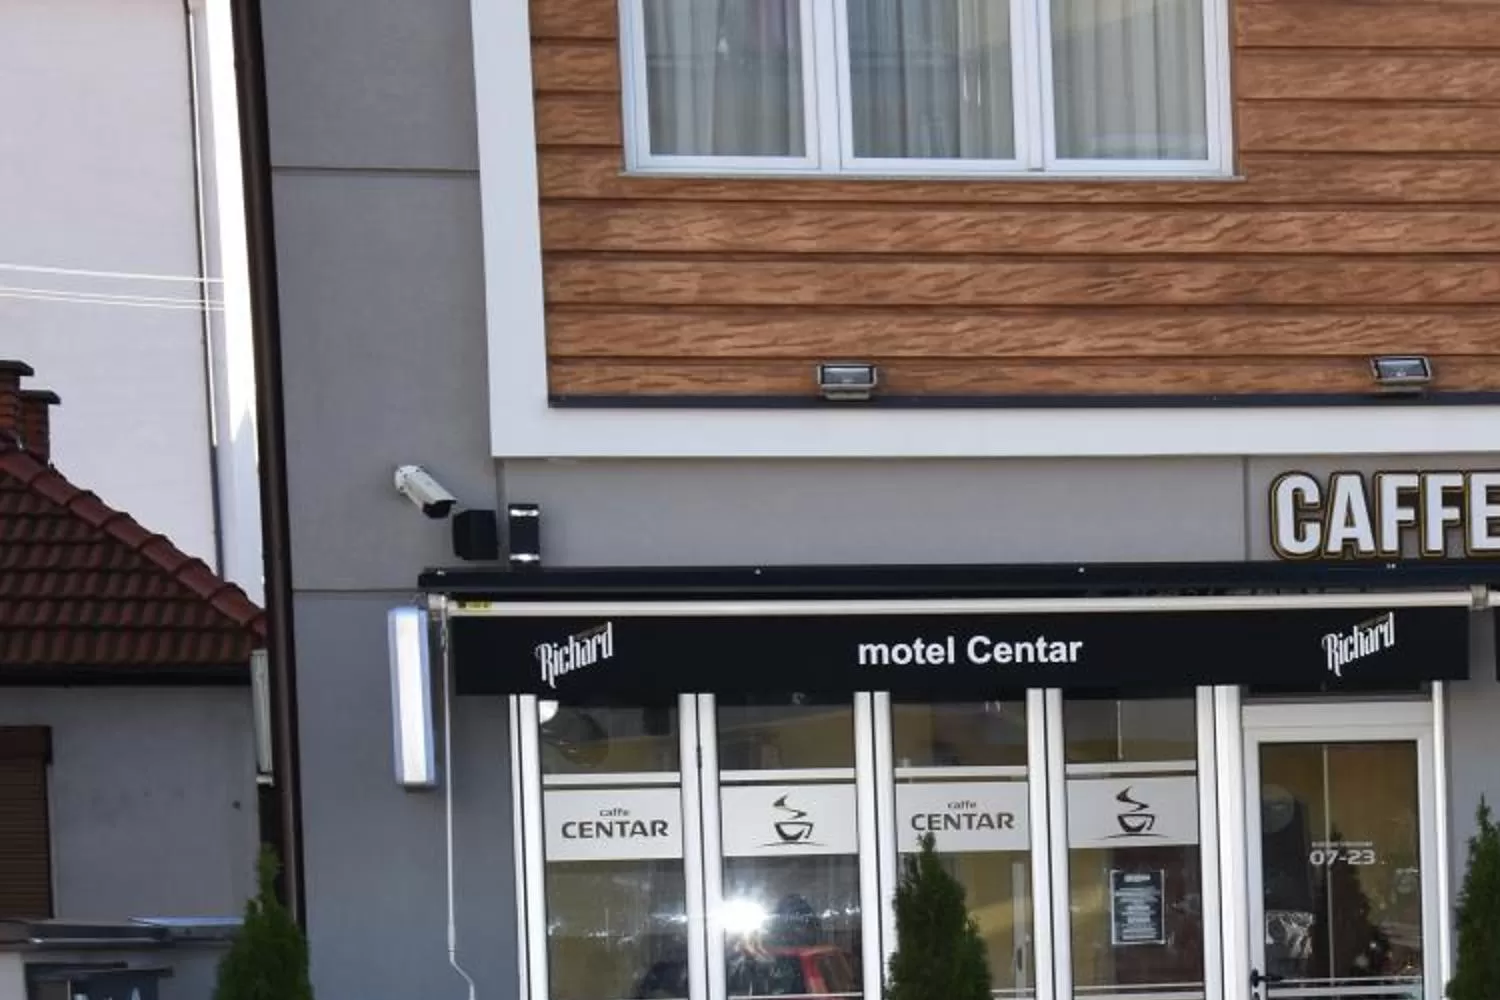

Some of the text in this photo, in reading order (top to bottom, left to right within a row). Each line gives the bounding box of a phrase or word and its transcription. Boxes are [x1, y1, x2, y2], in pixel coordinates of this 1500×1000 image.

[858, 633, 1084, 665] motel Centar
[1321, 611, 1395, 677] Richard
[535, 621, 613, 688] Richard
[599, 807, 630, 817] caffe
[947, 800, 977, 809] caffe
[561, 819, 669, 839] CENTAR
[911, 812, 1015, 831] CENTAR
[1309, 849, 1376, 866] 07-23
